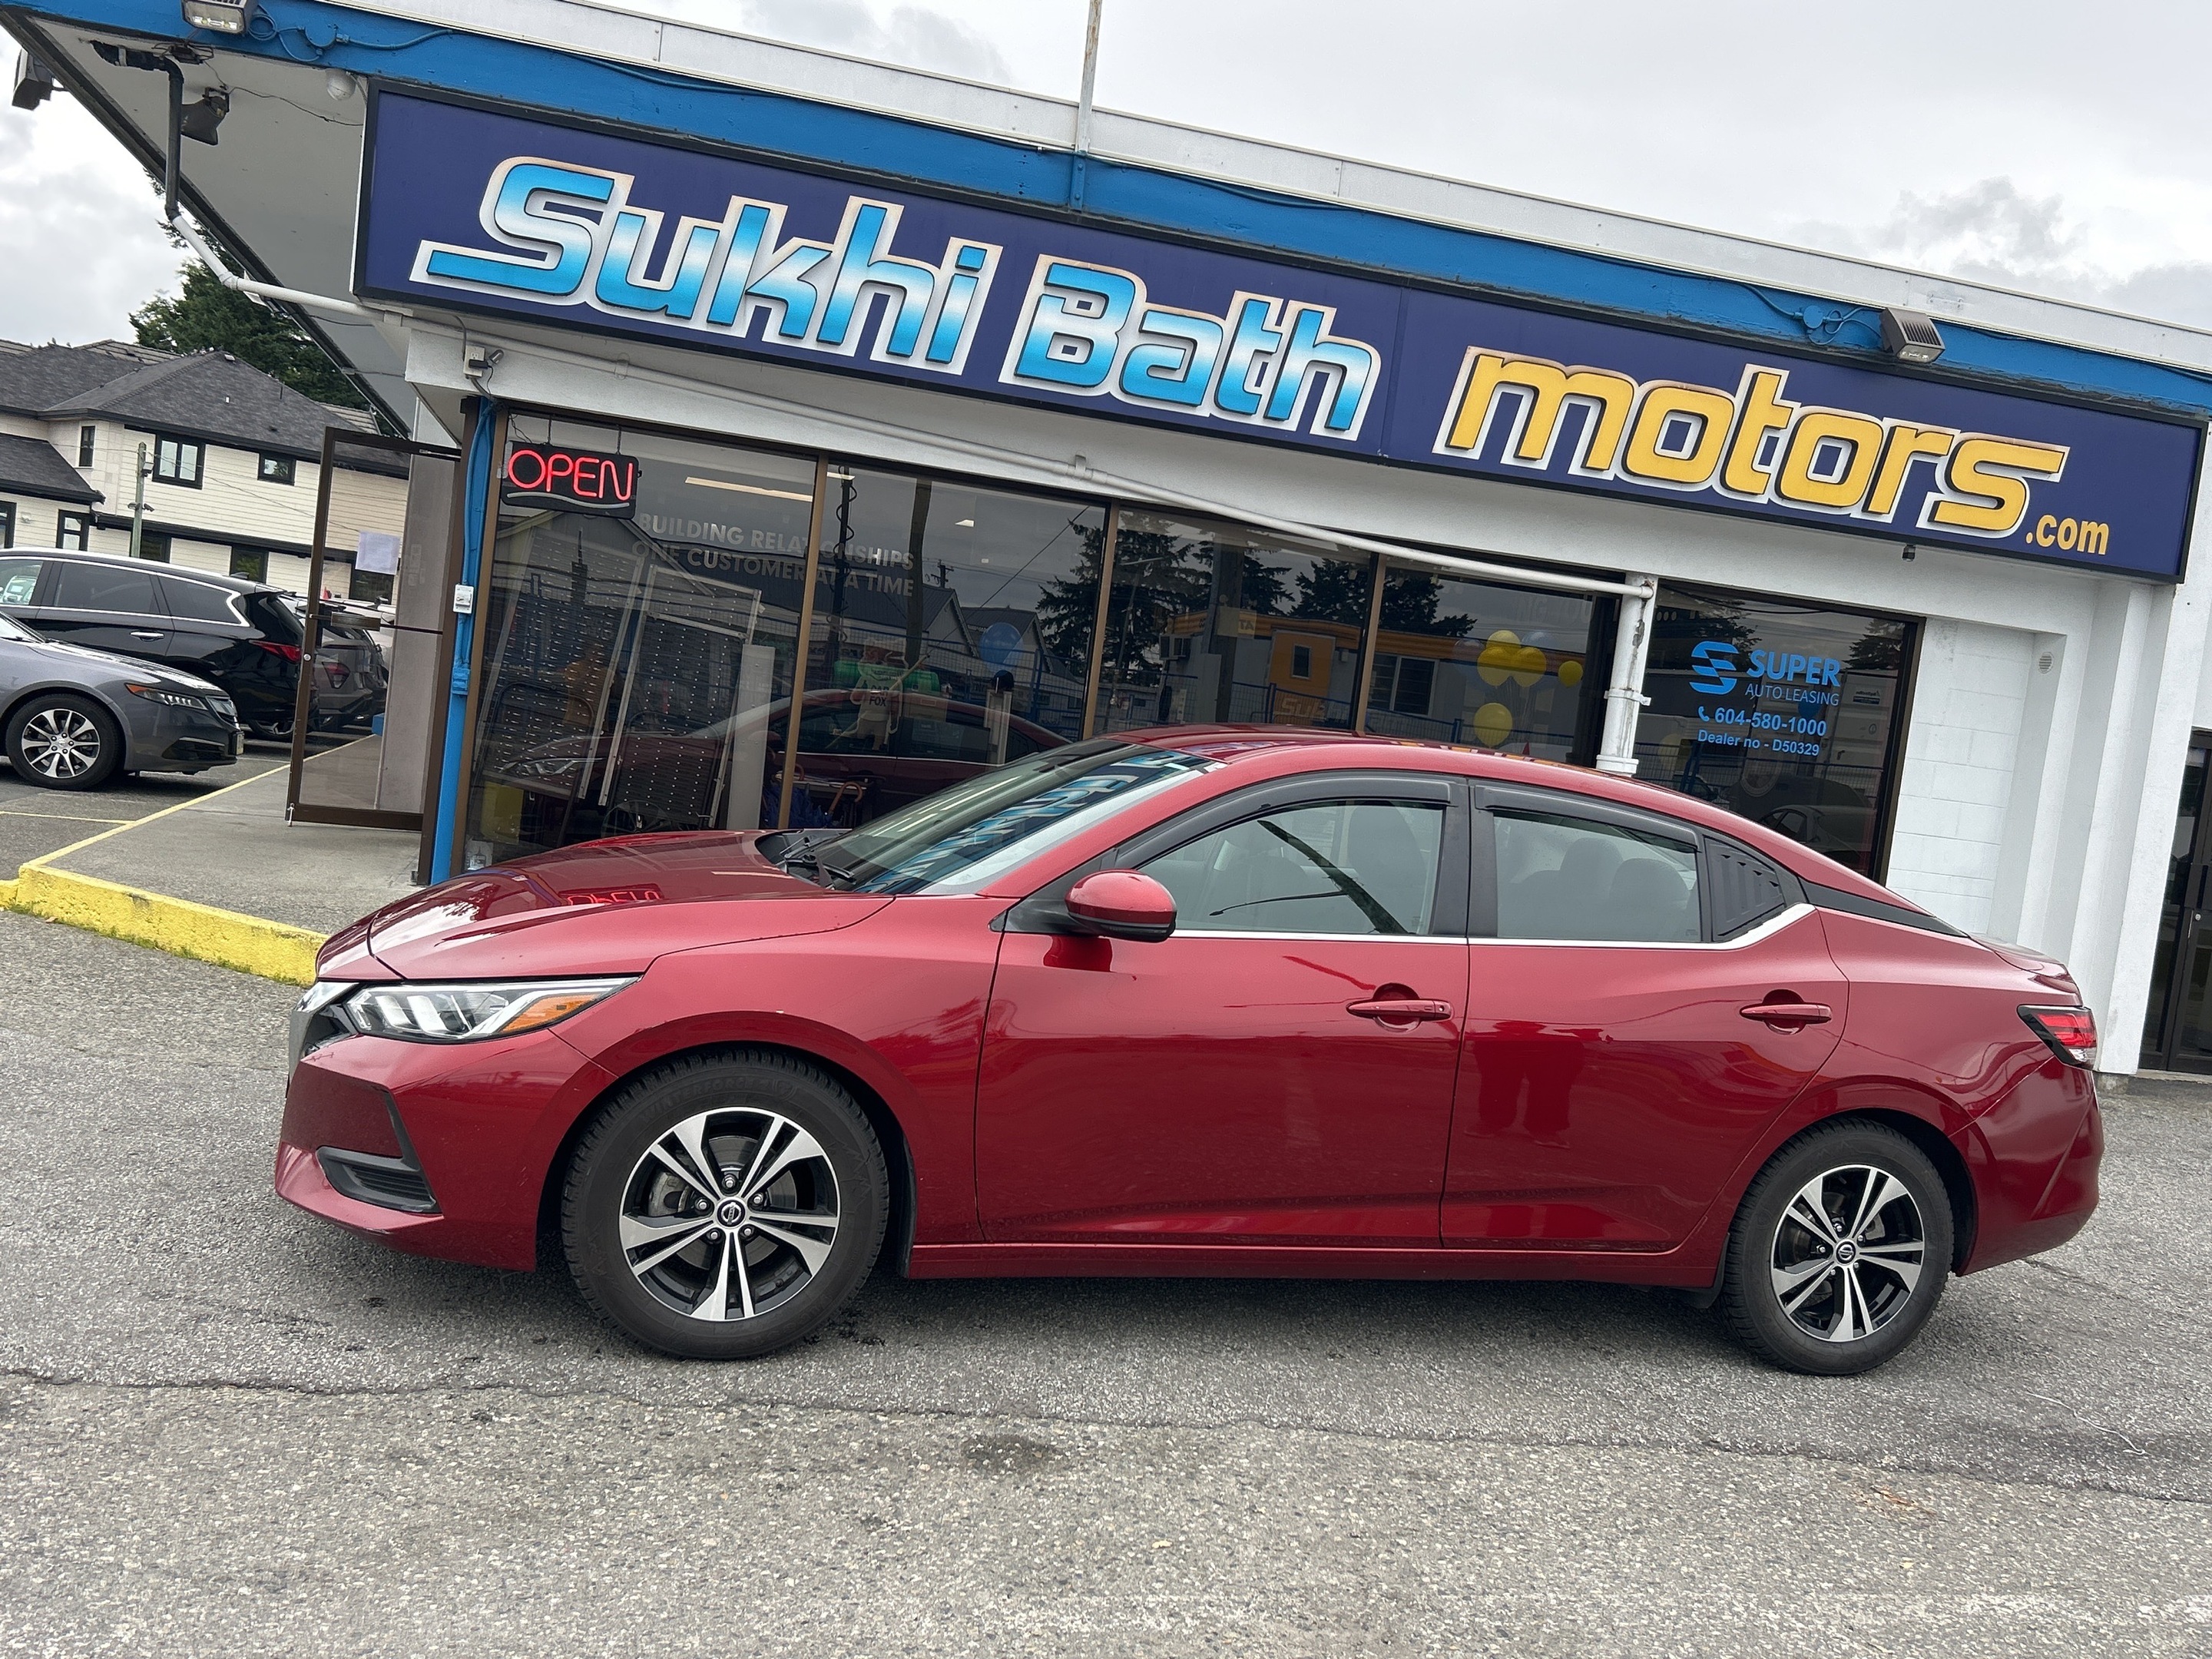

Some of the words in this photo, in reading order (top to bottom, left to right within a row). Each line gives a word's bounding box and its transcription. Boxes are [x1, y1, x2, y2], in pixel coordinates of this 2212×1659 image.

[409, 156, 1003, 376] Sukhi
[998, 253, 1381, 441] Bath
[1432, 345, 2071, 538] motors
[2025, 513, 2109, 556] .com
[508, 449, 634, 501] OPEN
[640, 513, 744, 545] BUILDING
[750, 529, 914, 571] RELATONSHIPS
[687, 548, 806, 581] CUSTOMER
[866, 571, 914, 597] TIME
[1746, 648, 1841, 687] SUPER
[869, 696, 886, 707] FOX
[1745, 682, 1783, 700] AUTO
[1786, 686, 1840, 707] LEASING
[1714, 707, 1827, 737] 604-580-1000
[1698, 730, 1739, 748] Dealer
[1744, 737, 1760, 750] no
[1773, 739, 1820, 757] D50329
